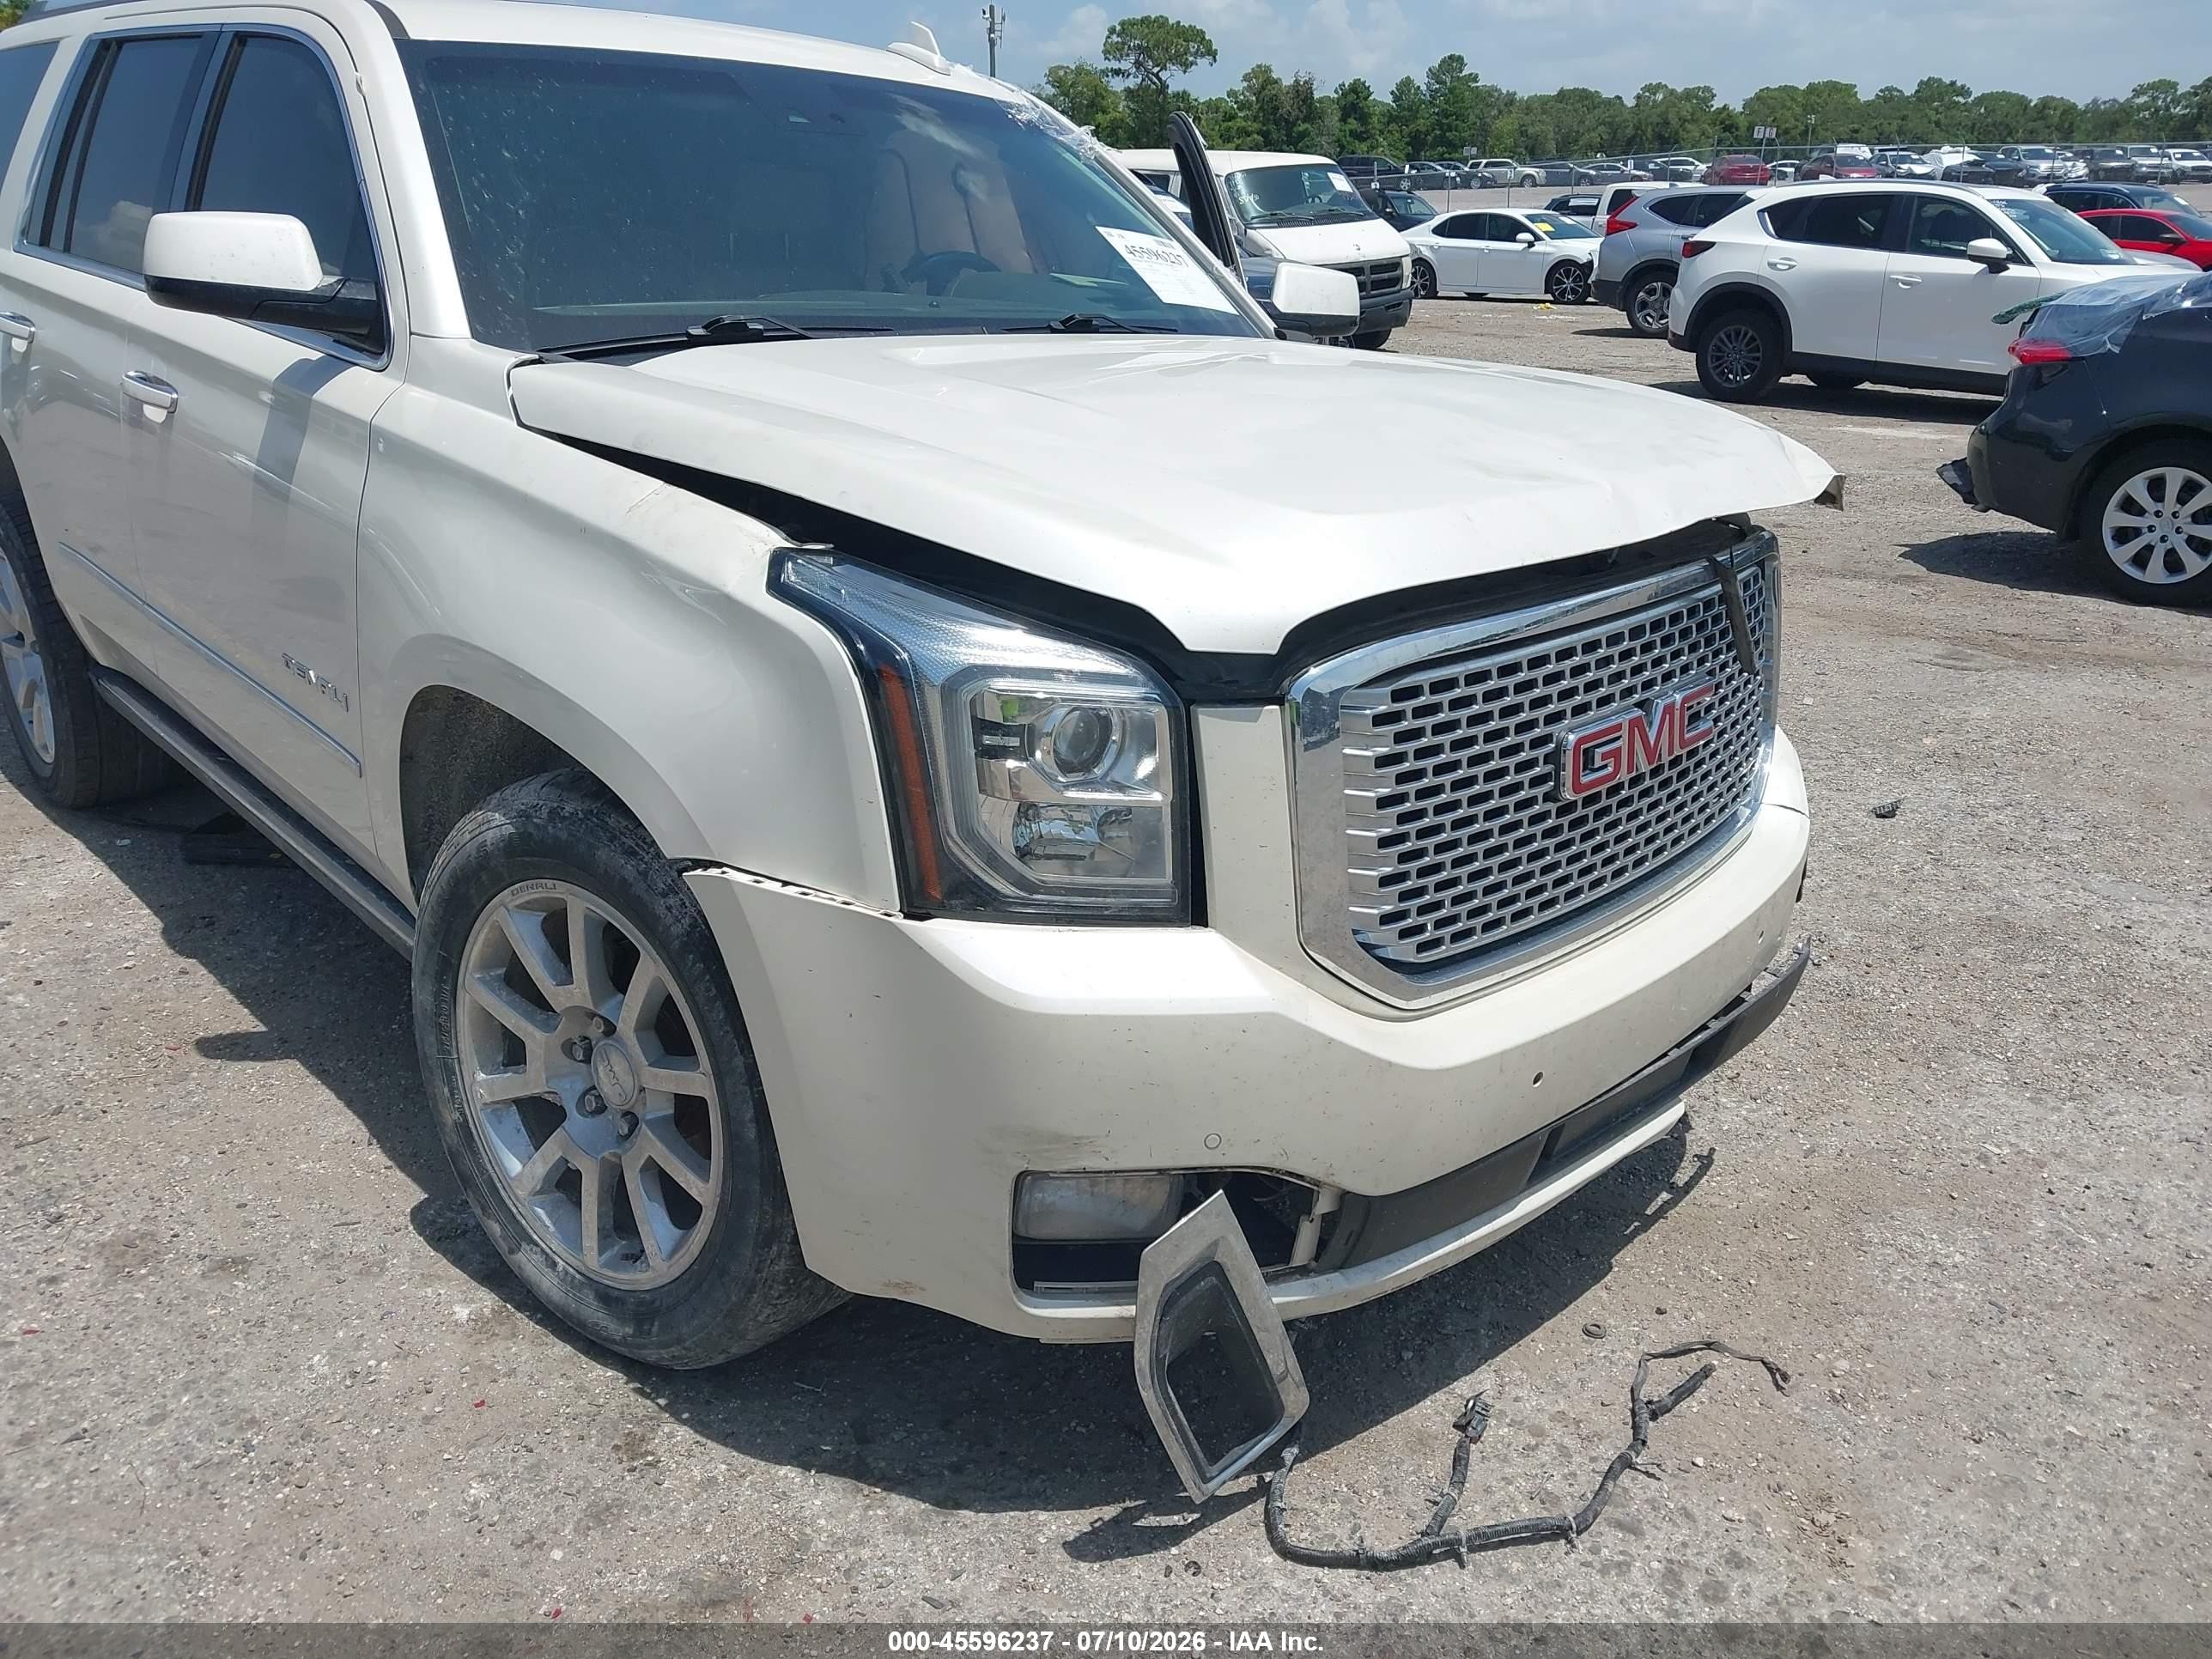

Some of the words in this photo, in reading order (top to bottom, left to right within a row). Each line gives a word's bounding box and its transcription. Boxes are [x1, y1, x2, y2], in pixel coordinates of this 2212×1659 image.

[1125, 244, 1189, 267] 45596237
[1563, 678, 1715, 799] GMC
[510, 882, 557, 896] DENALI
